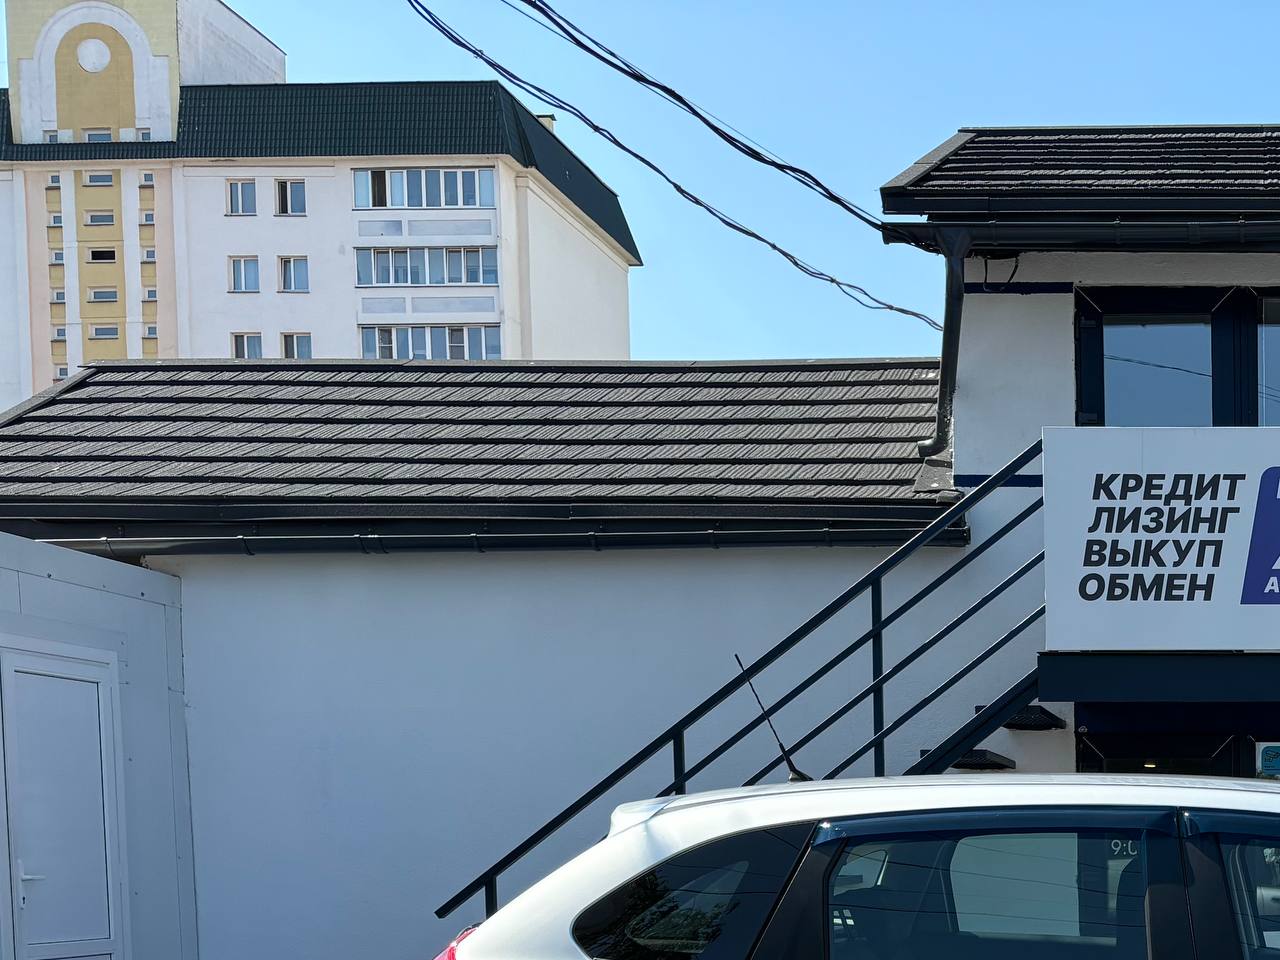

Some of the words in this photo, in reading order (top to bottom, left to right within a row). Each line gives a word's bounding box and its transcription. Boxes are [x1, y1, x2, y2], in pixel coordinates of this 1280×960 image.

[1092, 473, 1247, 507] КРЕДИТ
[1087, 506, 1241, 534] ЛИЗИНГ
[1082, 539, 1224, 568] ВЫКУП
[1078, 573, 1216, 602] ОБМЕН
